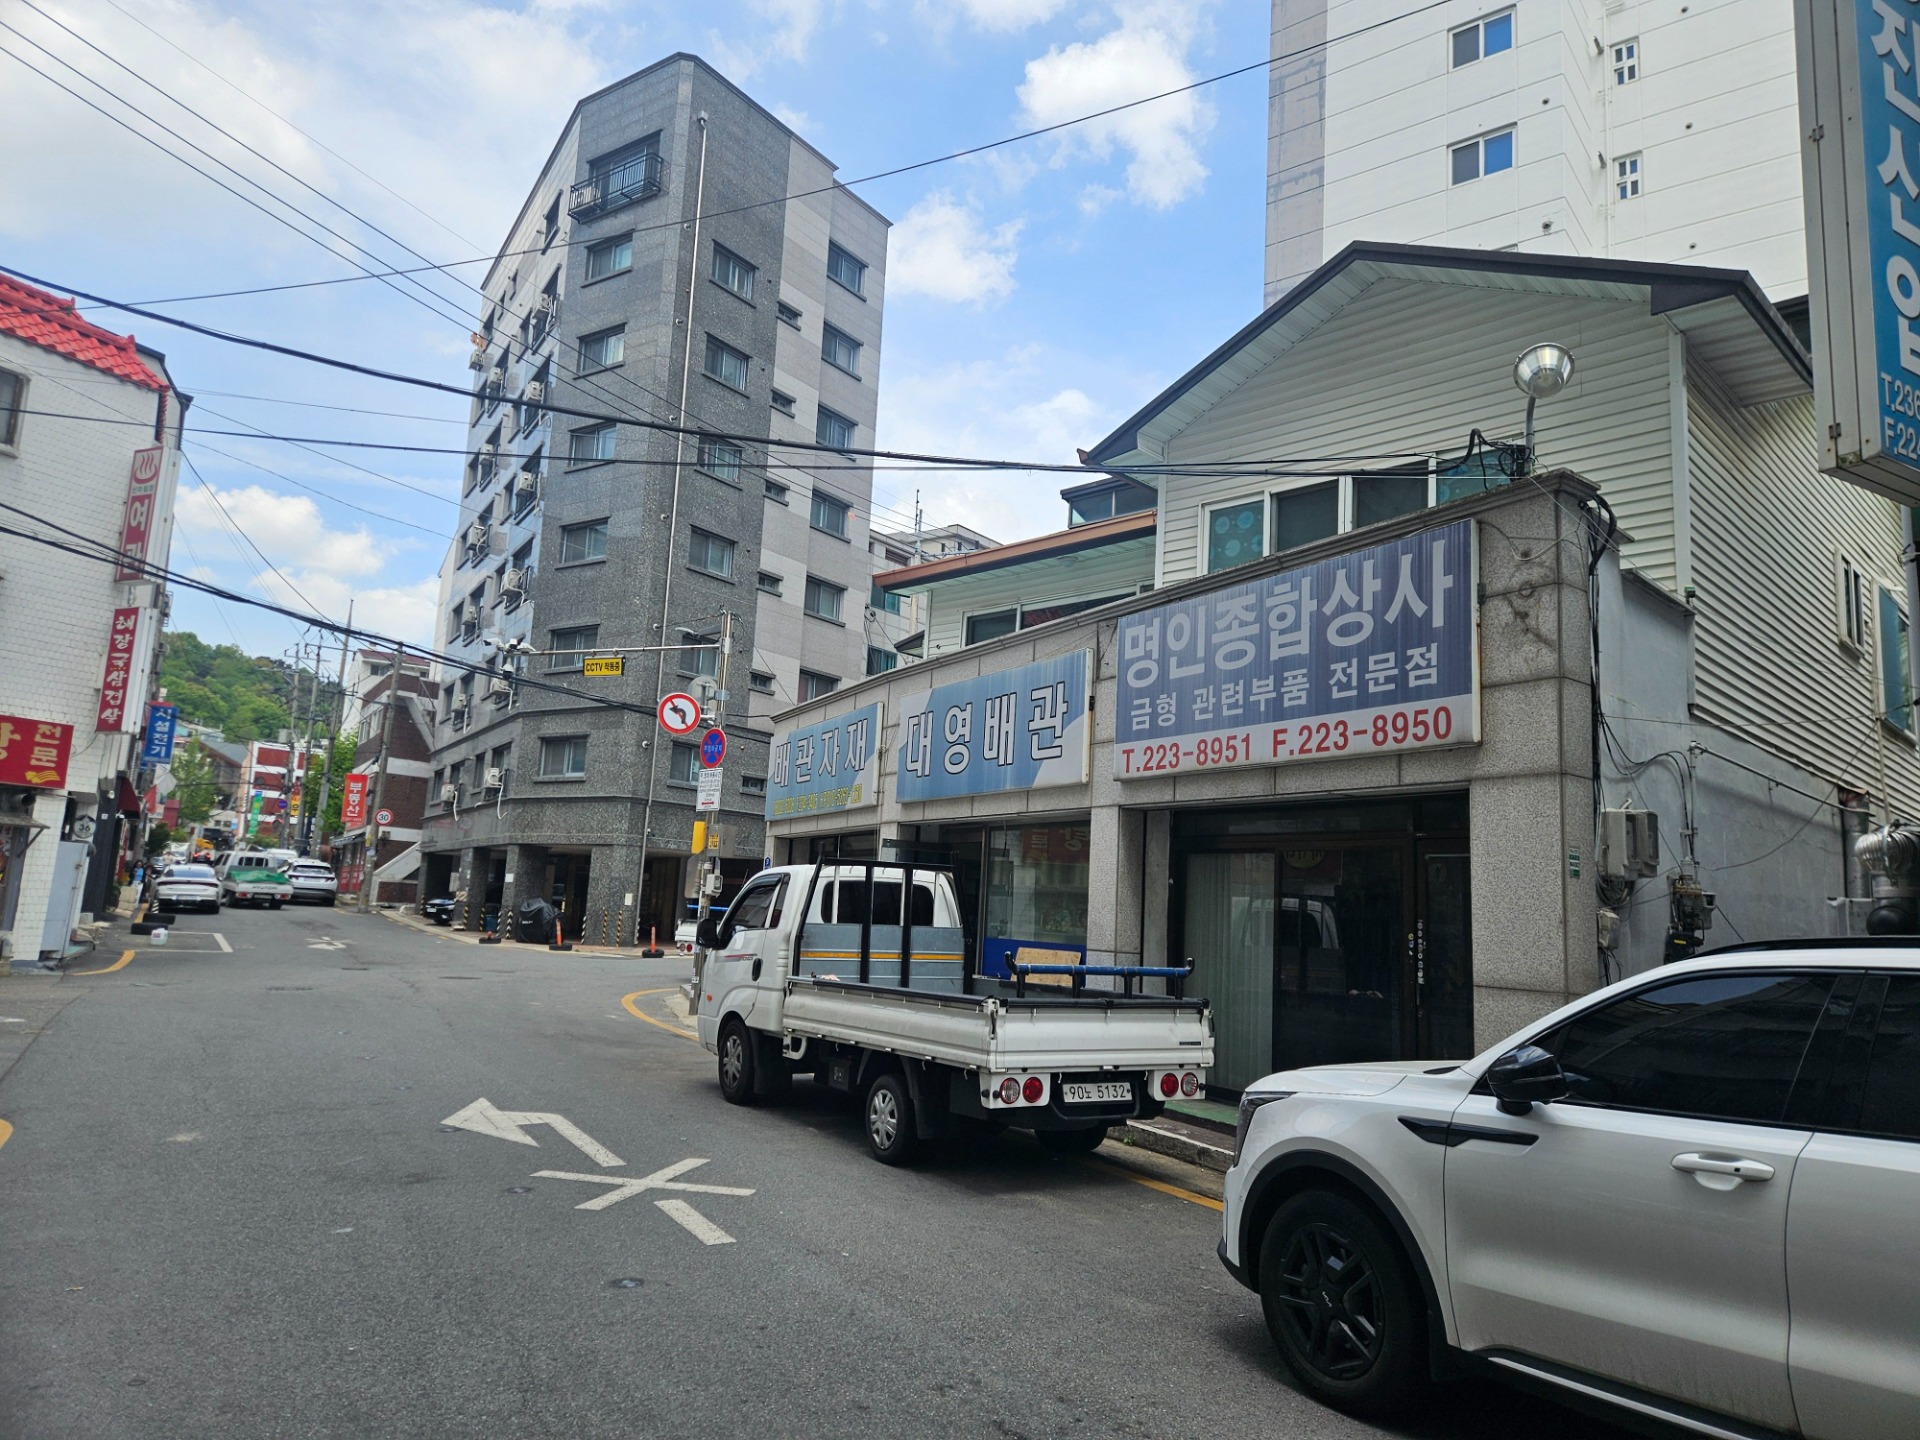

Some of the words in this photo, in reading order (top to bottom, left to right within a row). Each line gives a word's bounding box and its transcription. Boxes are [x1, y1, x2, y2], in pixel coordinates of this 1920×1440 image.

[1125, 539, 1455, 688] 명인종합상사
[586, 662, 603, 672] CCTV
[604, 661, 620, 672] 작동중
[1131, 693, 1177, 731] 금형
[1192, 668, 1310, 721] 관련부품
[1328, 642, 1438, 699] 전문점
[29, 723, 62, 768] 전문
[150, 708, 172, 757] 시설전기
[773, 718, 869, 787] 배관자재
[905, 681, 1069, 778] 대영배관
[1122, 732, 1251, 773] T.223-8951
[1272, 705, 1453, 757] F.223-8950
[346, 782, 363, 817] 부동산
[378, 813, 389, 822] 30
[78, 823, 91, 833] 36
[1069, 1085, 1092, 1100] 90노
[1097, 1084, 1126, 1099] 5132
